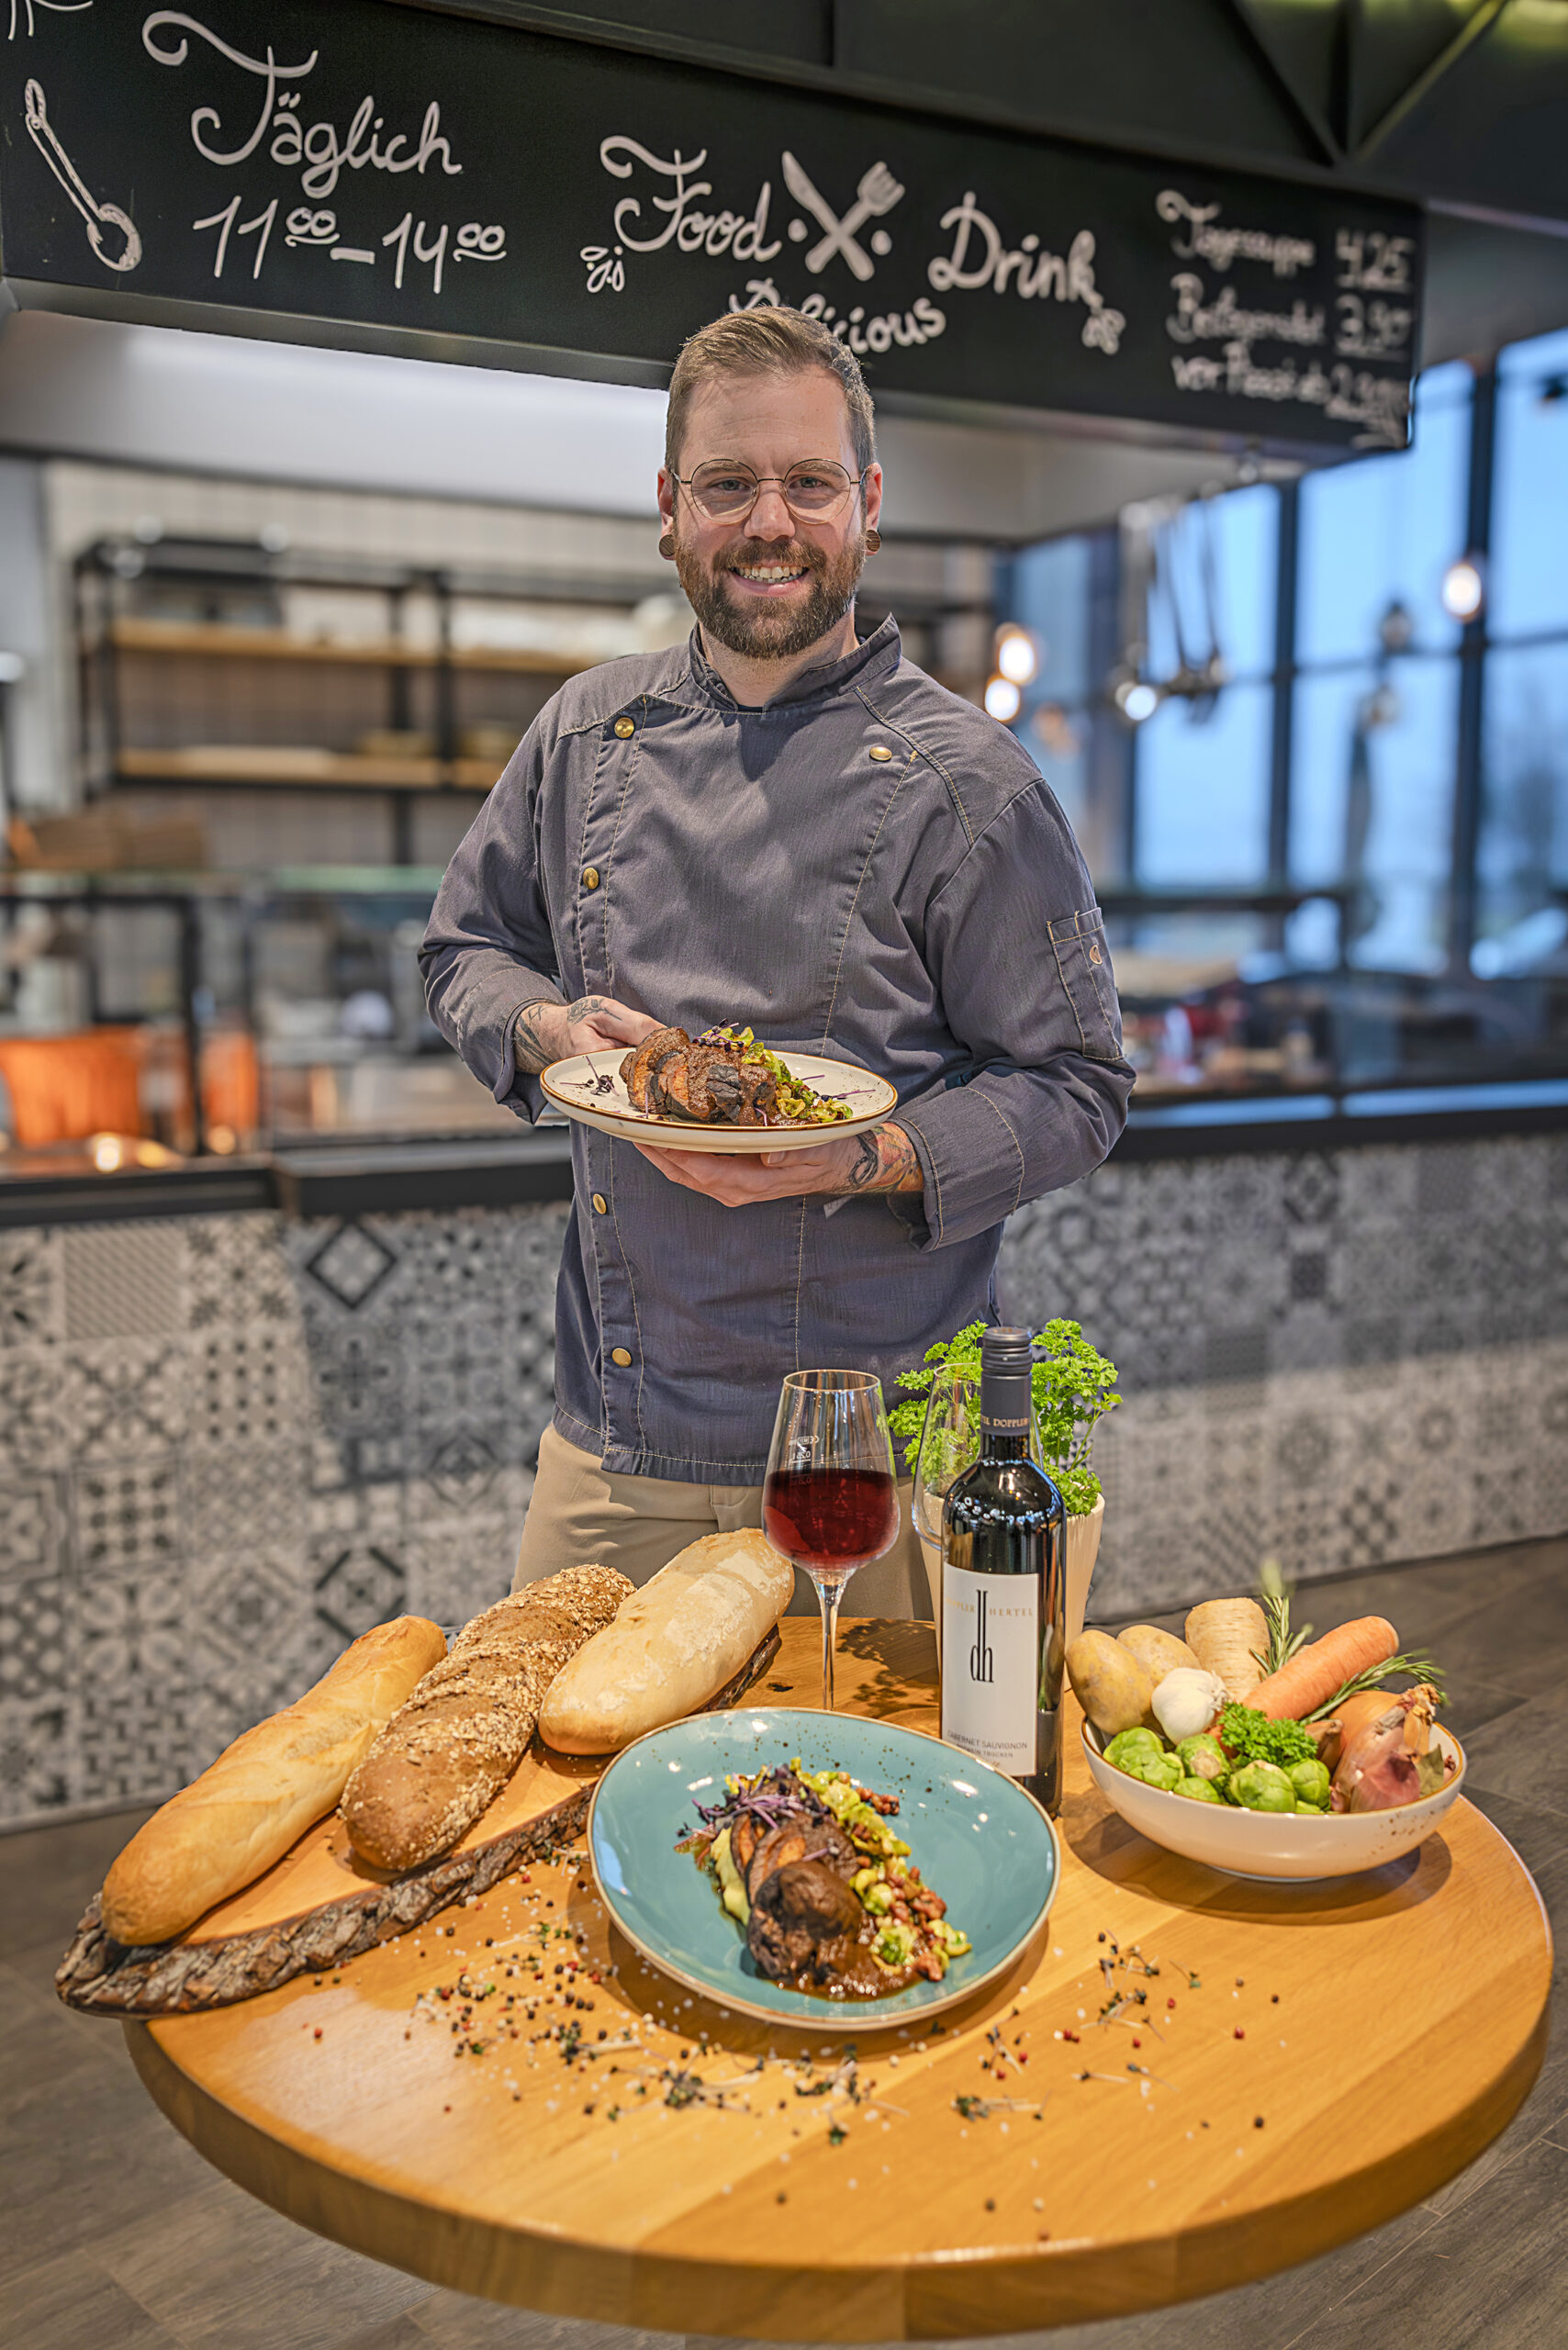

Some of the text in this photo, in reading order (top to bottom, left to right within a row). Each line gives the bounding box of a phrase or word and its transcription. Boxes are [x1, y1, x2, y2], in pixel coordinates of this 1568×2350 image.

[142, 10, 462, 199] Täglich
[600, 136, 1094, 303] Food Drink
[990, 1607, 1034, 1617] HERTEL
[982, 1740, 1028, 1750] SAUVIGNON
